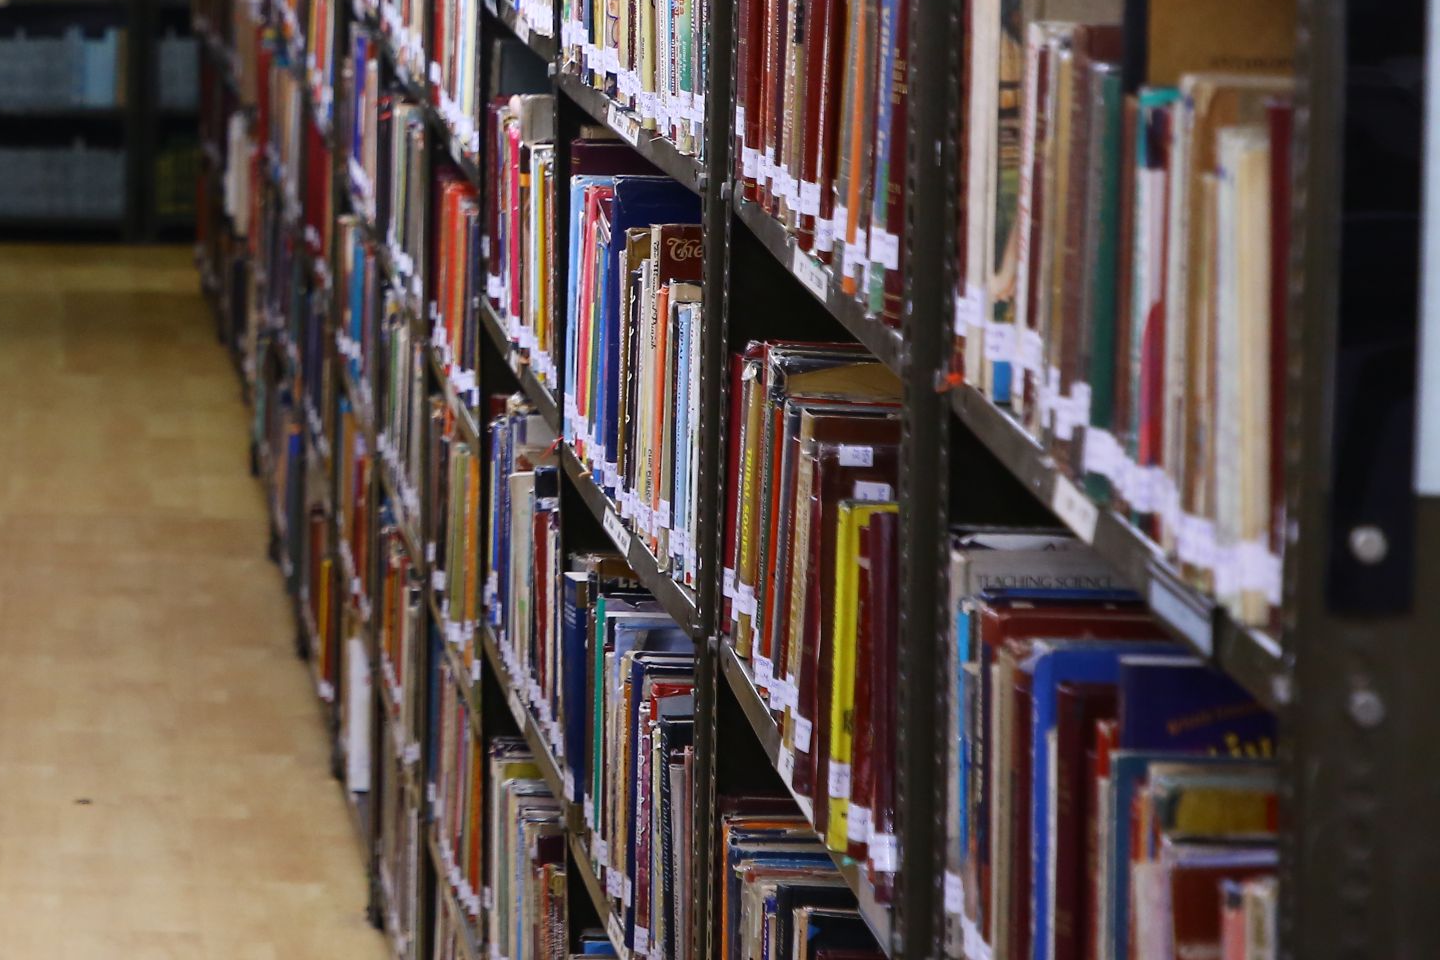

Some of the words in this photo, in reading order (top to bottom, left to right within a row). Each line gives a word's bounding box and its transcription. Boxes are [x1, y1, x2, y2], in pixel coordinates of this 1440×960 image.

[666, 236, 703, 262] The
[743, 447, 753, 499] TRIBAL
[741, 503, 751, 569] SOCIETY
[1054, 573, 1112, 588] SCIENC
